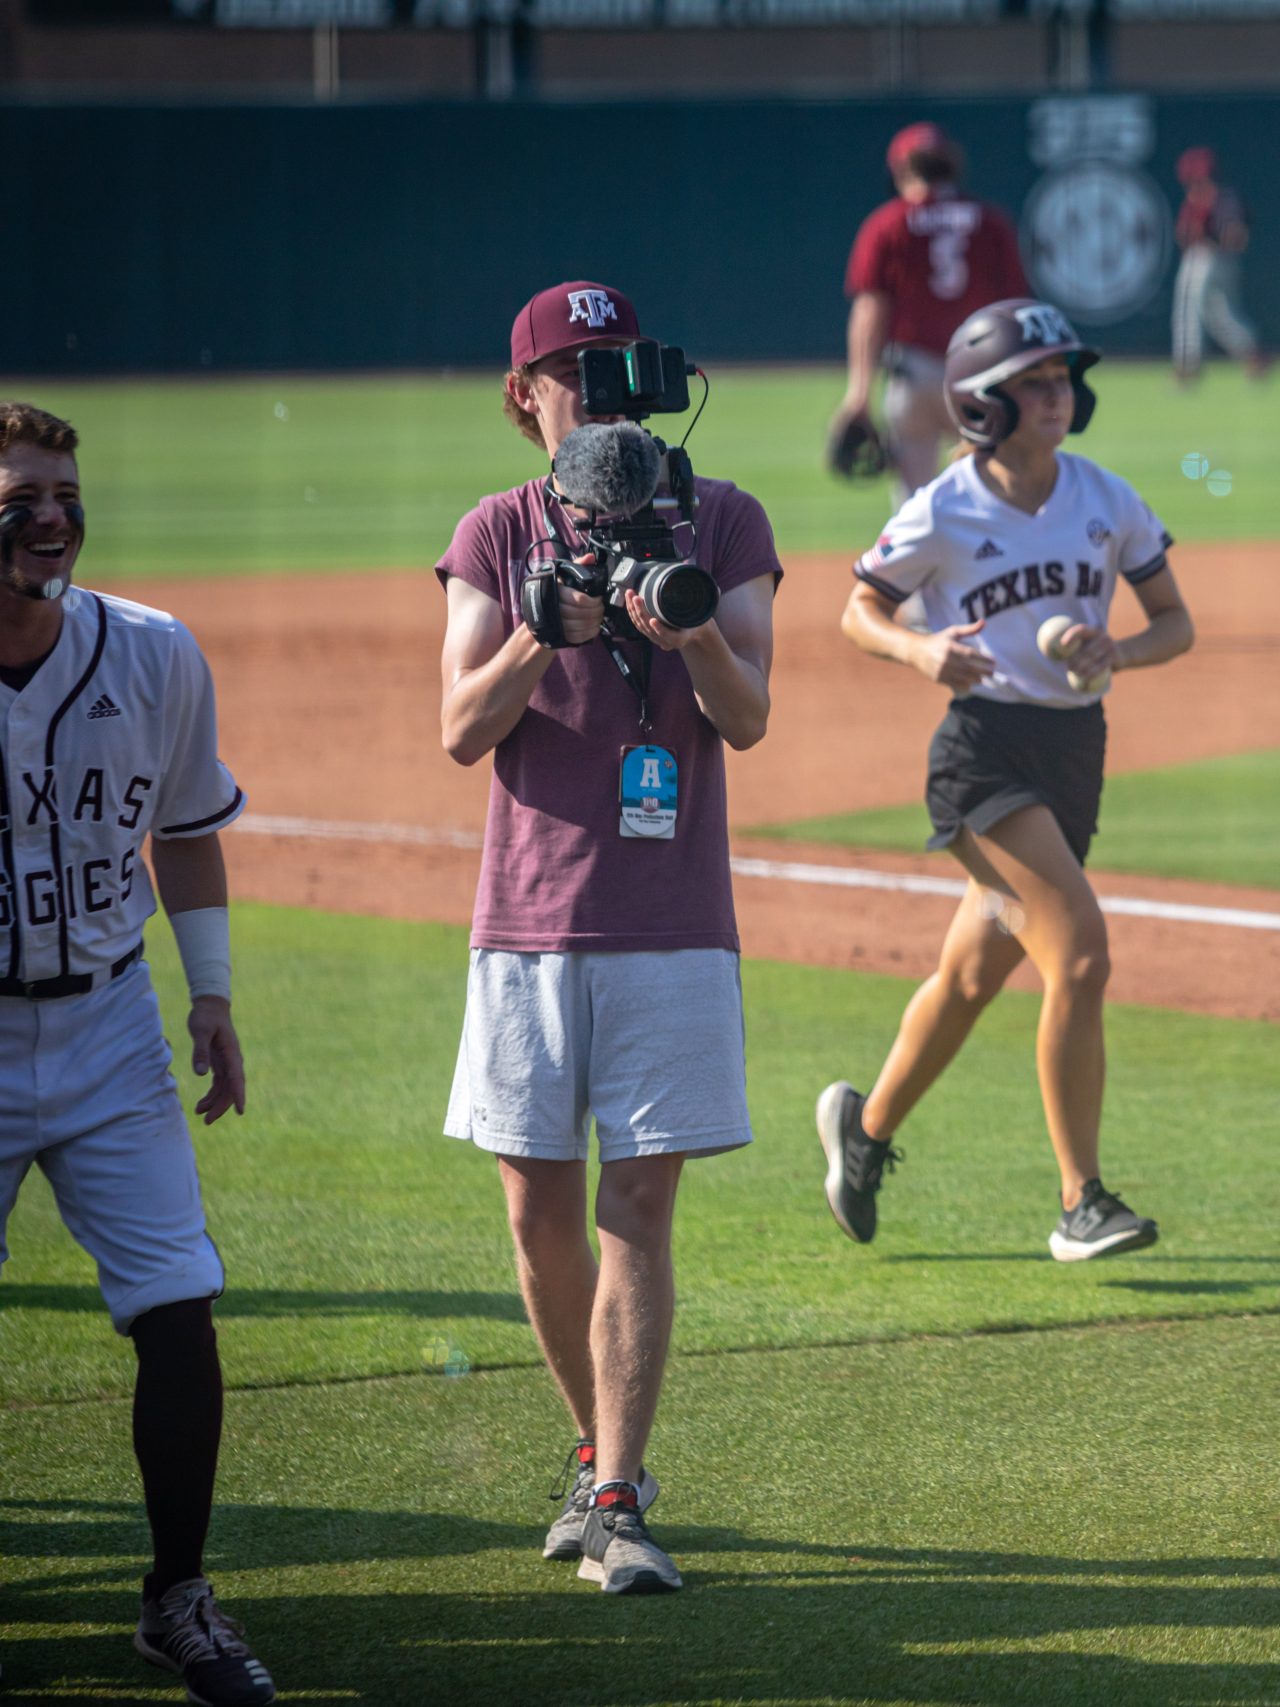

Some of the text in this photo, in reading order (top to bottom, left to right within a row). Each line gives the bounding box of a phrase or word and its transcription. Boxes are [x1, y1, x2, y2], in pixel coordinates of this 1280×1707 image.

[960, 560, 1065, 623] TEXAS
[87, 708, 121, 719] adidas
[640, 758, 662, 788] A
